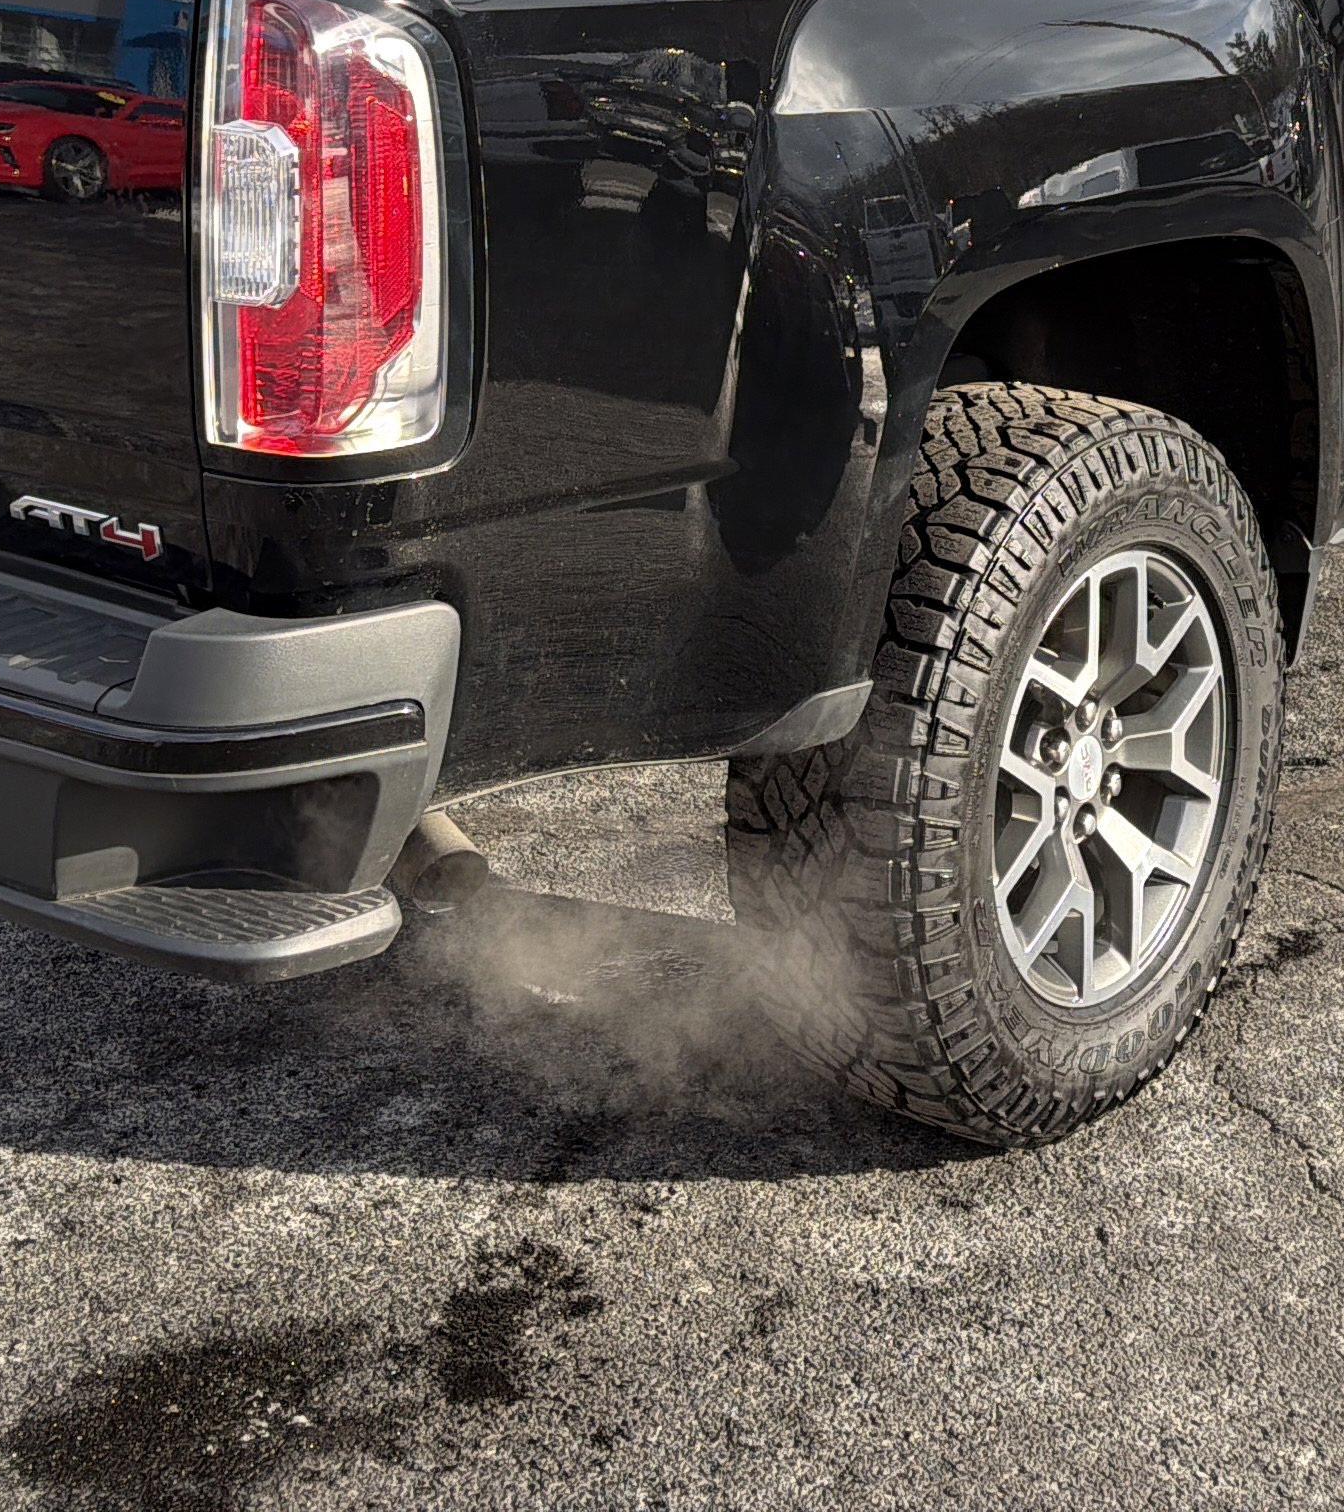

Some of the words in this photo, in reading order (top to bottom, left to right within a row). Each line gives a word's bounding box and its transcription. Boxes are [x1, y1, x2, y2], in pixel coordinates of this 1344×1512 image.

[10, 495, 164, 561] AT4
[1058, 494, 1268, 668] WRANGLER
[974, 896, 1202, 1076] GOODYEAR
